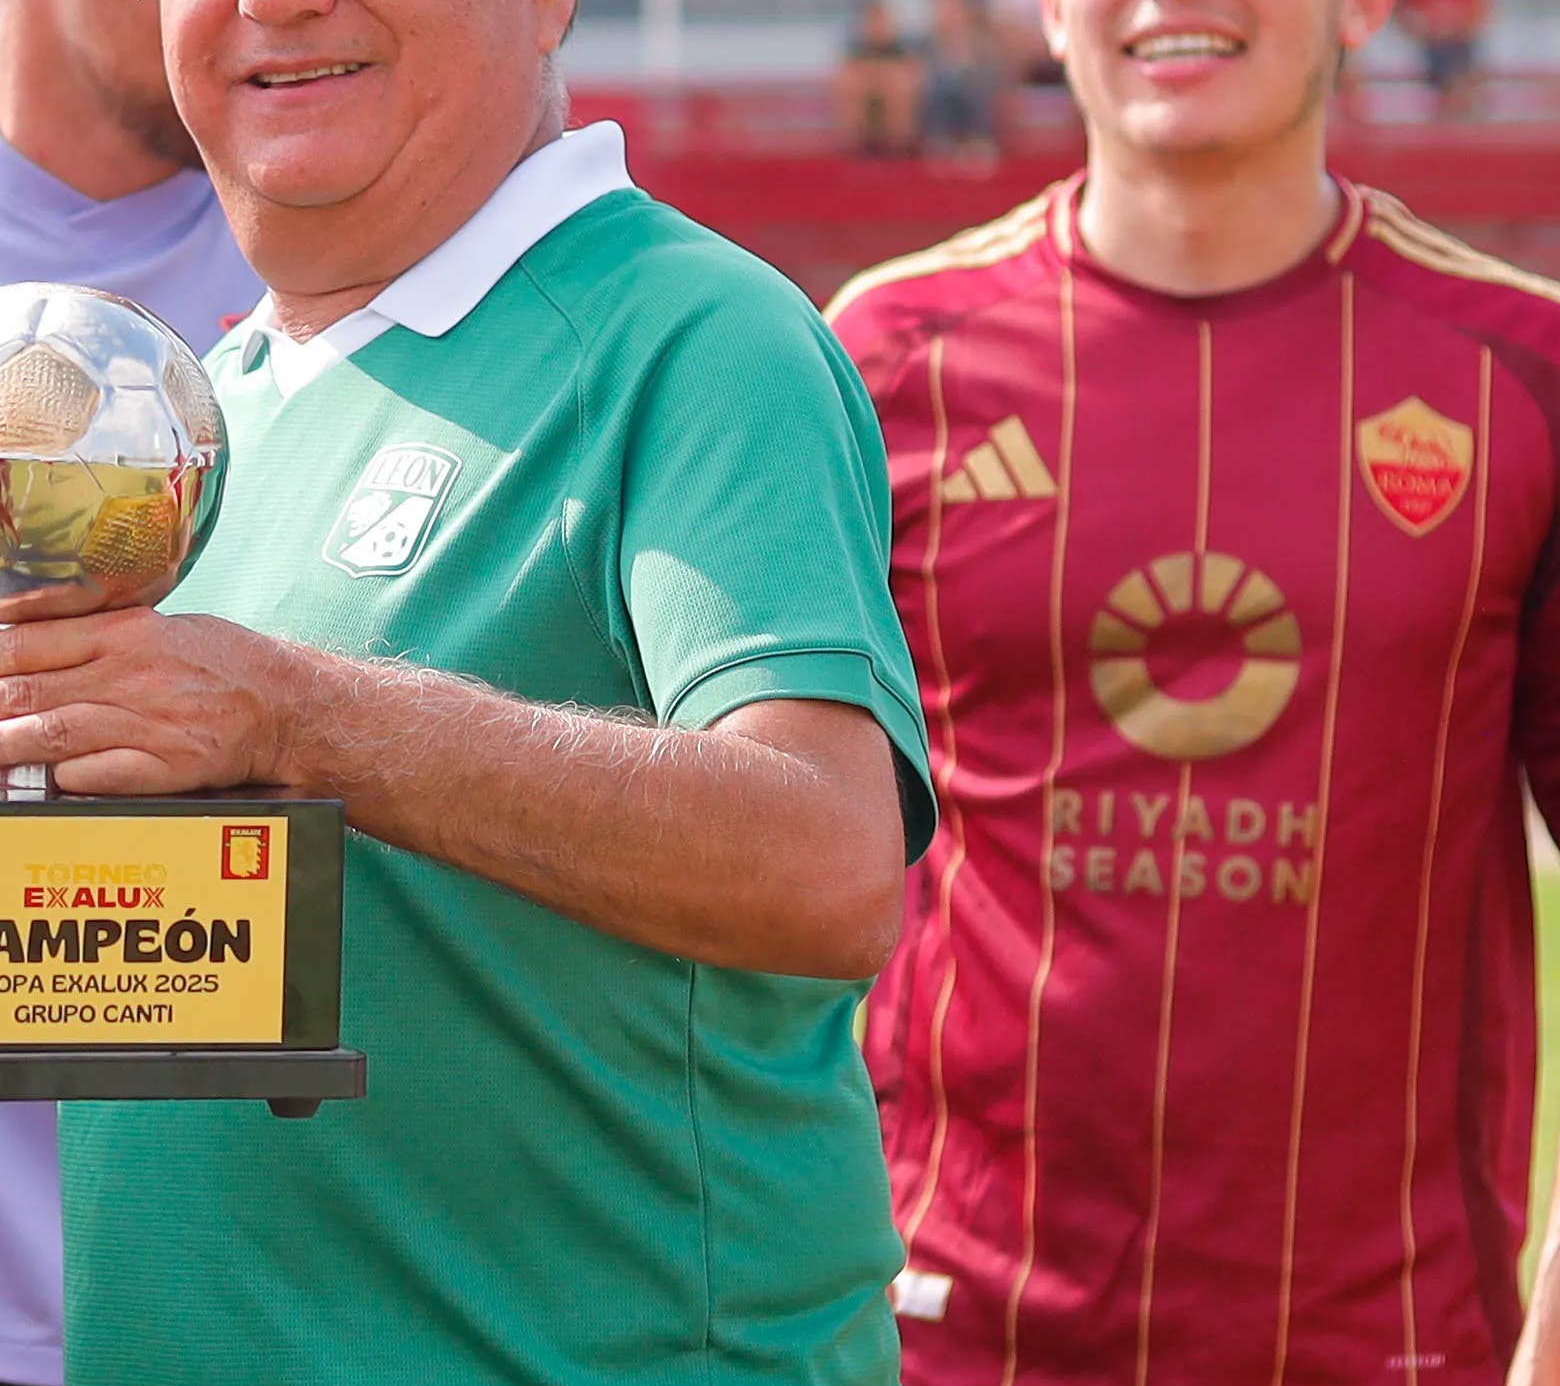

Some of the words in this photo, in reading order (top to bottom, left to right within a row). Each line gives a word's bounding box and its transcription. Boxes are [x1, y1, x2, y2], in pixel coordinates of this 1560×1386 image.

[1052, 788, 1320, 849] RIYADH
[23, 862, 167, 885] TORNEO
[1048, 844, 1316, 905] SEASON
[23, 887, 166, 908] EXALUX
[51, 974, 149, 994] EXALUX
[154, 974, 220, 994] 2025
[13, 1004, 97, 1024] GRUPO
[102, 1004, 174, 1024] CANTI
